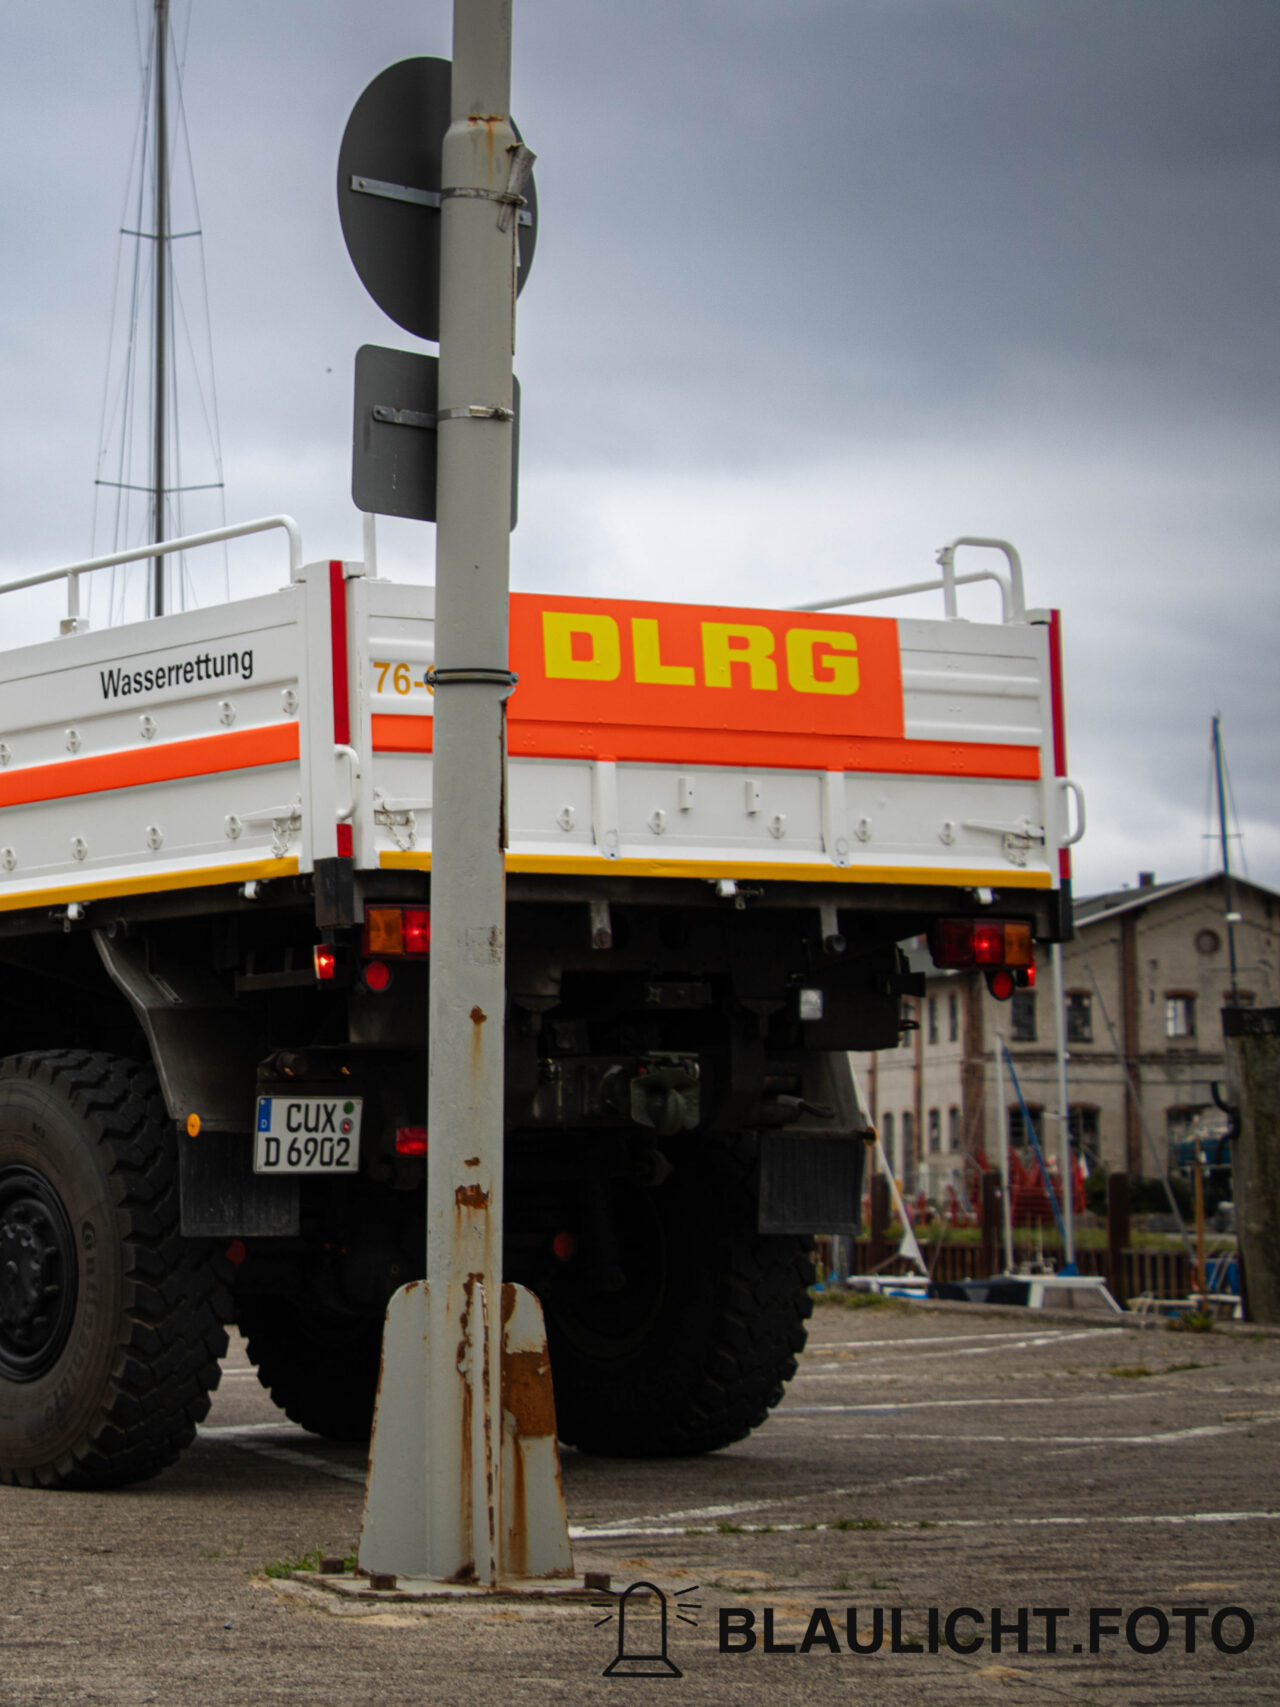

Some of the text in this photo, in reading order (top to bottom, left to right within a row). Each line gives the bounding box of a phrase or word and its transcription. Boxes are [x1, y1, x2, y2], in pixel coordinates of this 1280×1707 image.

[542, 611, 860, 696] DLRG
[100, 649, 254, 700] Wasserrettung
[261, 1119, 268, 1129] D
[286, 1103, 337, 1133] CUX
[264, 1137, 350, 1167] D 6902
